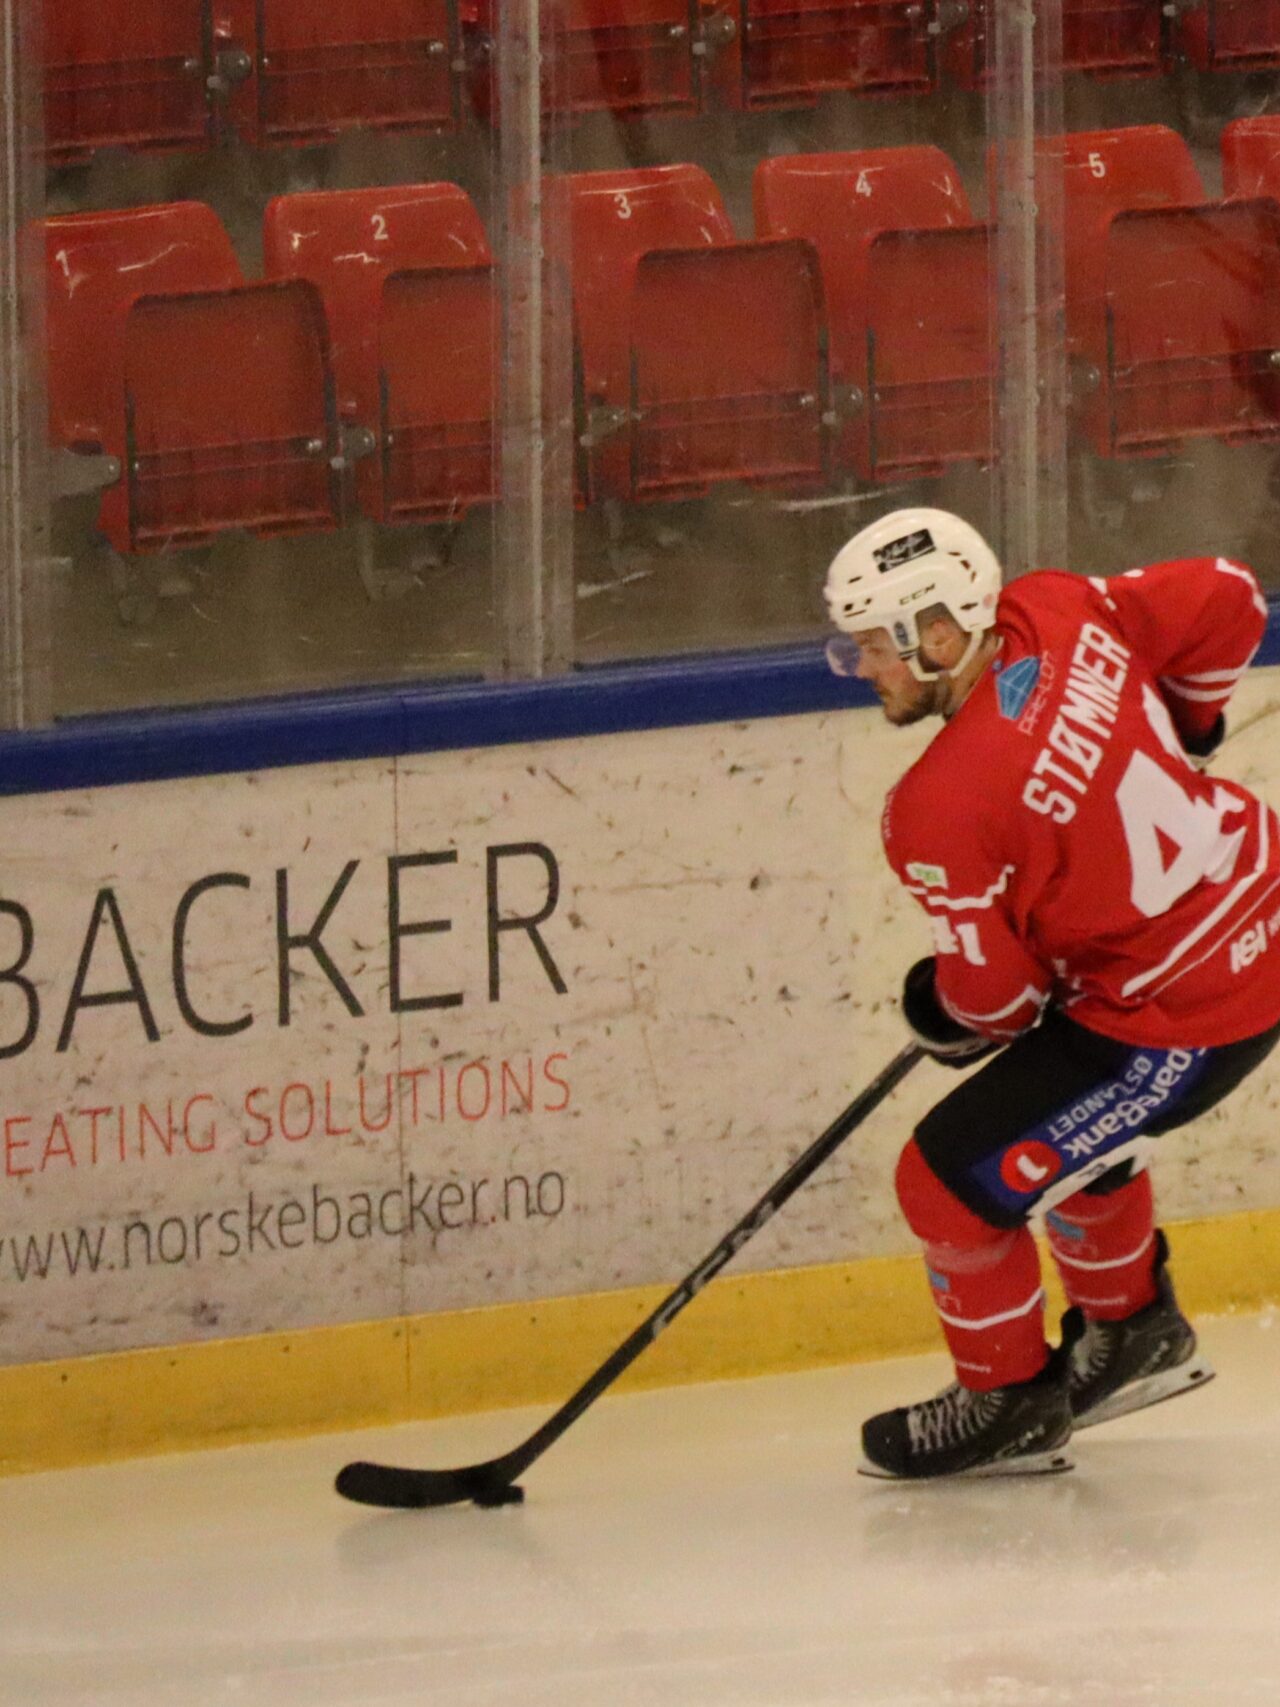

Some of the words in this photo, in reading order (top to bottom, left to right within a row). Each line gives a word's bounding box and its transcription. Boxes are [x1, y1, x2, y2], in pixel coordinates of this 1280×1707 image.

[1090, 153, 1105, 178] 5
[856, 172, 871, 197] 4
[616, 194, 632, 219] 3
[371, 214, 388, 240] 2
[55, 250, 70, 277] 1
[898, 583, 936, 606] CCM
[1021, 622, 1132, 825] STØMNER
[0, 841, 569, 1060] BACKER
[4, 1094, 219, 1178] EATING
[244, 1052, 572, 1147] SOLUTIONS
[0, 1167, 567, 1283] ww.norskebacker.no
